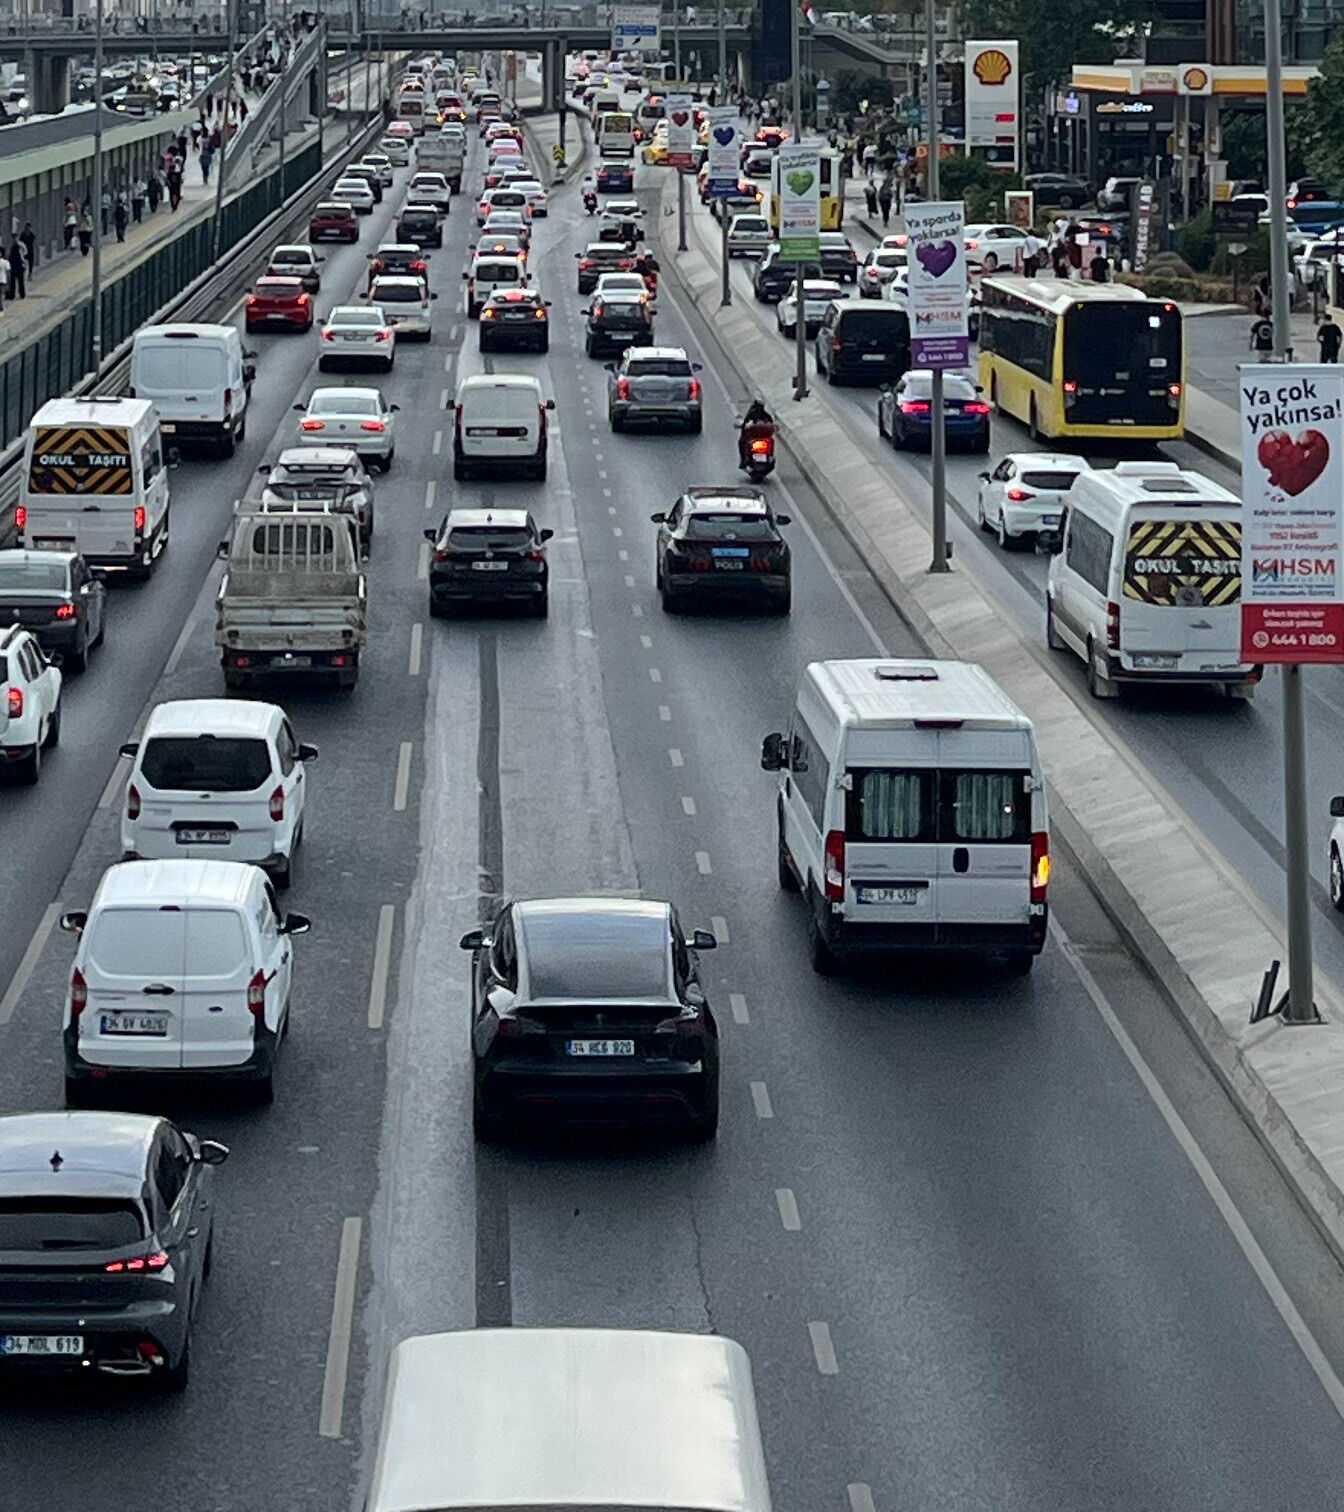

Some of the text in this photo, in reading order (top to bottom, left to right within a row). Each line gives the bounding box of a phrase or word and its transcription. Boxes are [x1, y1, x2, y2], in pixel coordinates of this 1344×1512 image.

[1243, 379, 1317, 407] Ya çok
[1247, 399, 1342, 434] yakınsa!
[39, 454, 75, 465] OKUL
[1134, 558, 1181, 574] OKUL
[1271, 634, 1298, 645] 444
[6, 1336, 23, 1352] 34
[56, 1337, 80, 1352] 619
